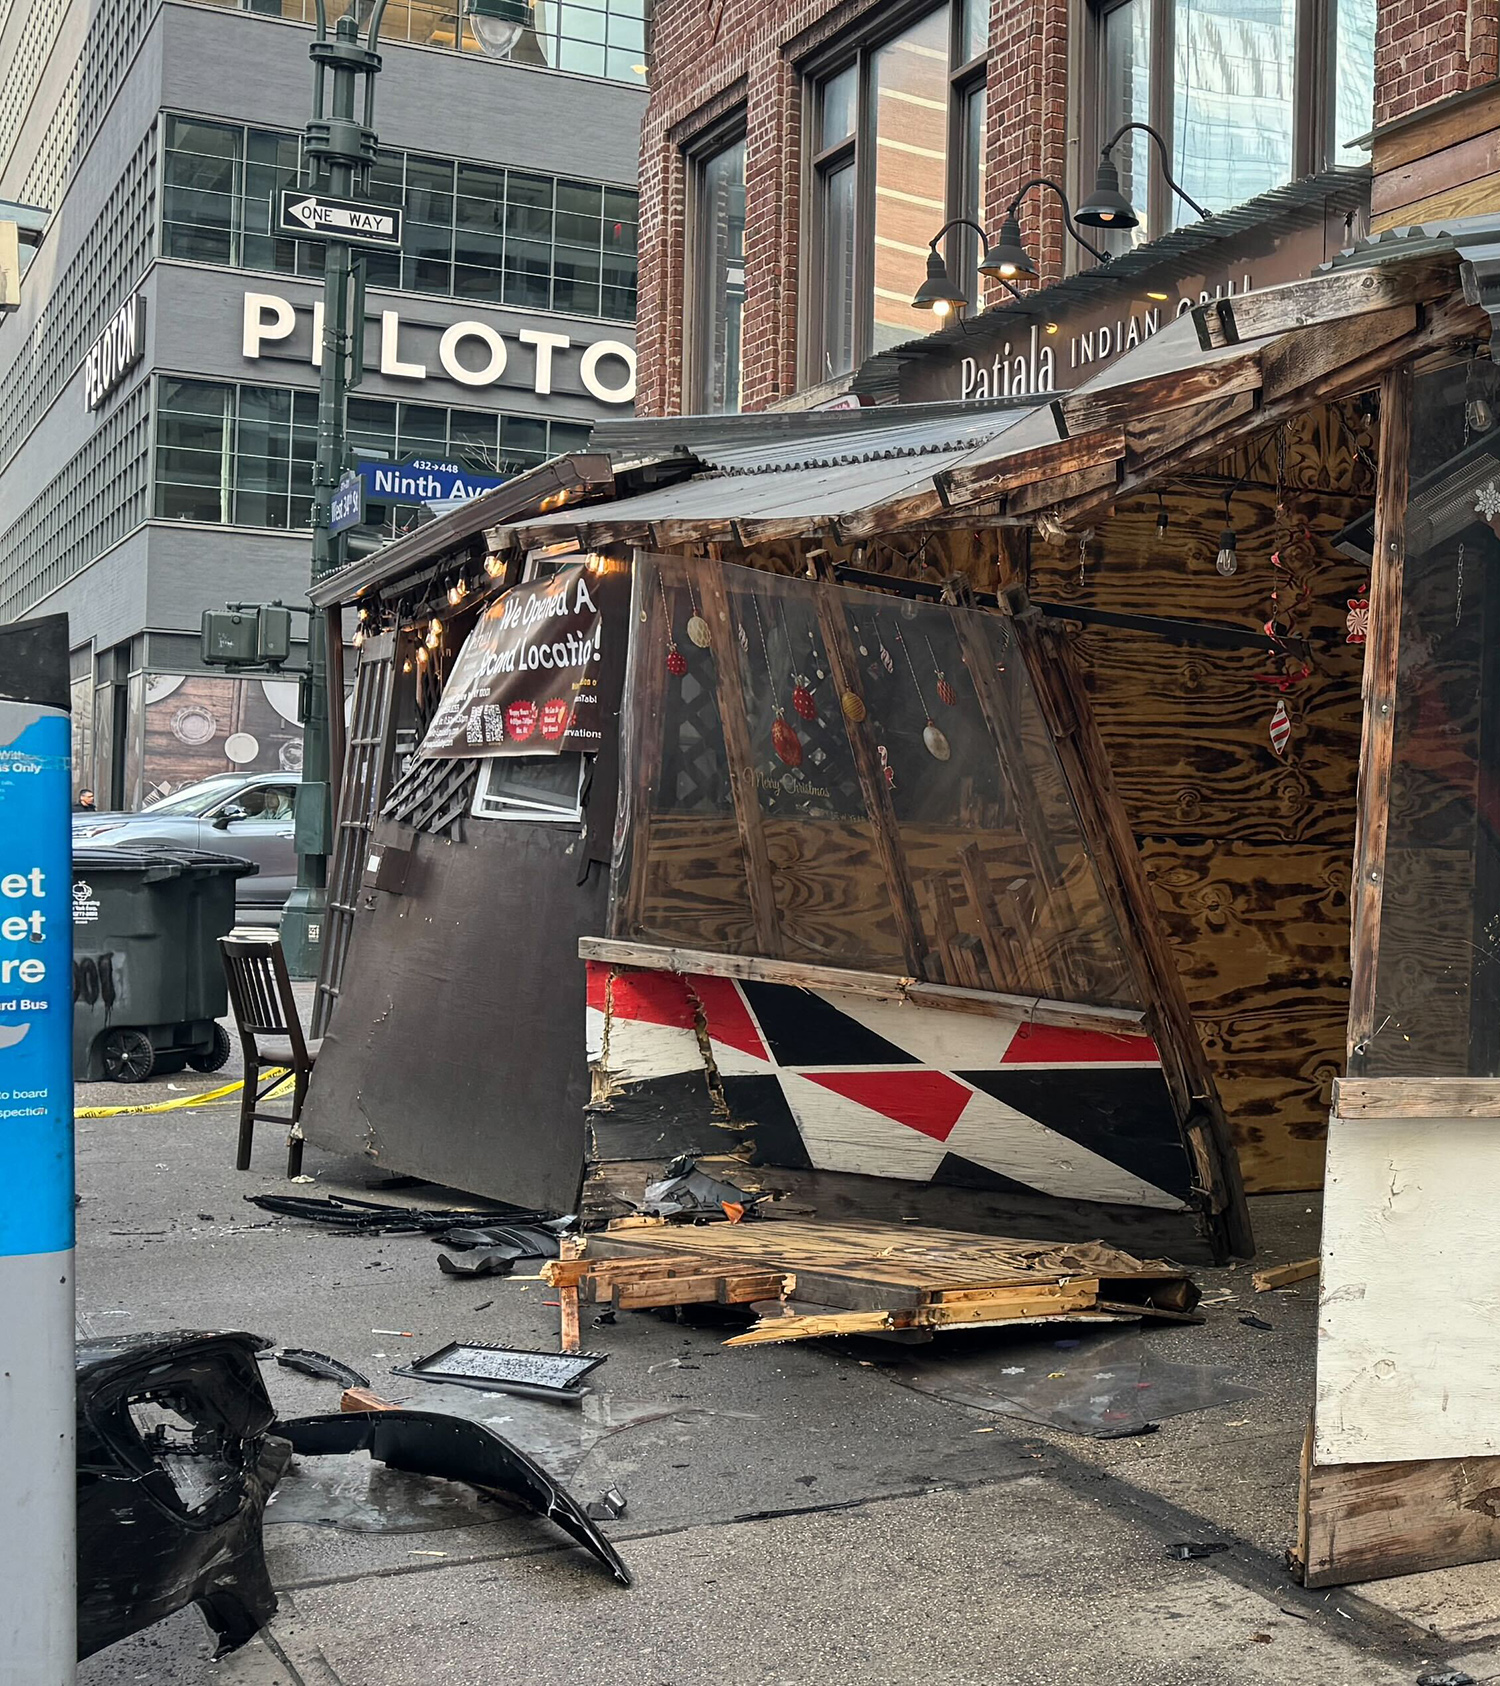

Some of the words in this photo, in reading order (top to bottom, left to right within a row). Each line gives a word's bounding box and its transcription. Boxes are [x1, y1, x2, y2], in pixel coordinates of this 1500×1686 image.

[301, 205, 333, 223] ONE
[349, 212, 384, 231] WAY
[85, 292, 137, 414] PELOTON
[961, 324, 1057, 401] Patiala
[1071, 308, 1160, 369] INDIAN
[413, 460, 431, 471] 432
[439, 463, 459, 474] 448
[375, 470, 442, 498] Ninth
[500, 598, 522, 630] We
[522, 579, 569, 634] Opened
[573, 578, 597, 615] A
[12, 762, 42, 775] Only
[743, 766, 780, 797] Merry
[781, 773, 830, 798] Christmas
[1, 867, 46, 899] et
[1, 958, 46, 984] re
[0, 999, 17, 1011] rd
[20, 999, 48, 1010] Bus
[12, 1087, 48, 1099] board
